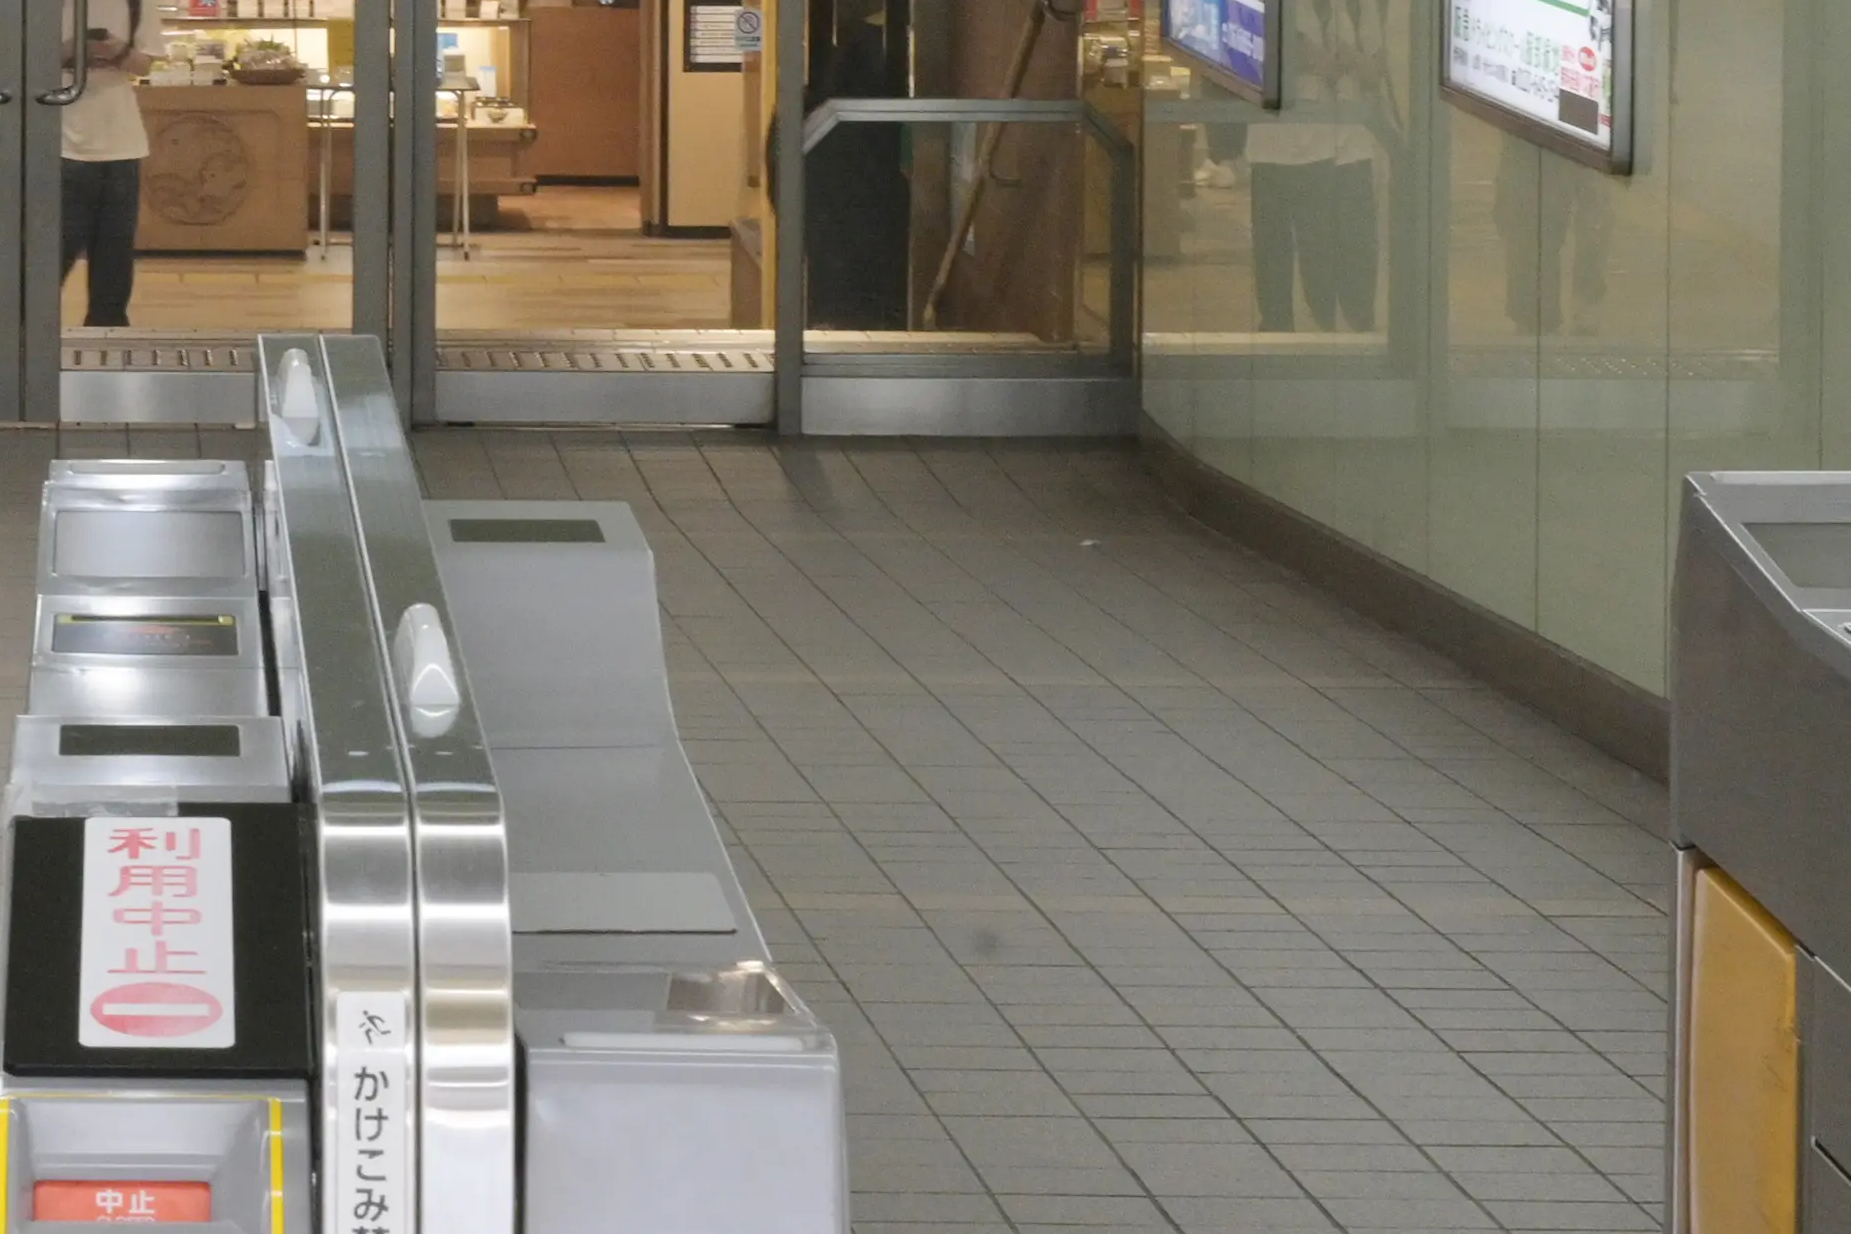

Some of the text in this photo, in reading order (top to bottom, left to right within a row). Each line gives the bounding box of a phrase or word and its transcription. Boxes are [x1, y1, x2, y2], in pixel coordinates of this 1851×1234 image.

[105, 826, 208, 976] 利用中止
[95, 1188, 156, 1214] 中止
[352, 1066, 390, 1234] かけこみ
